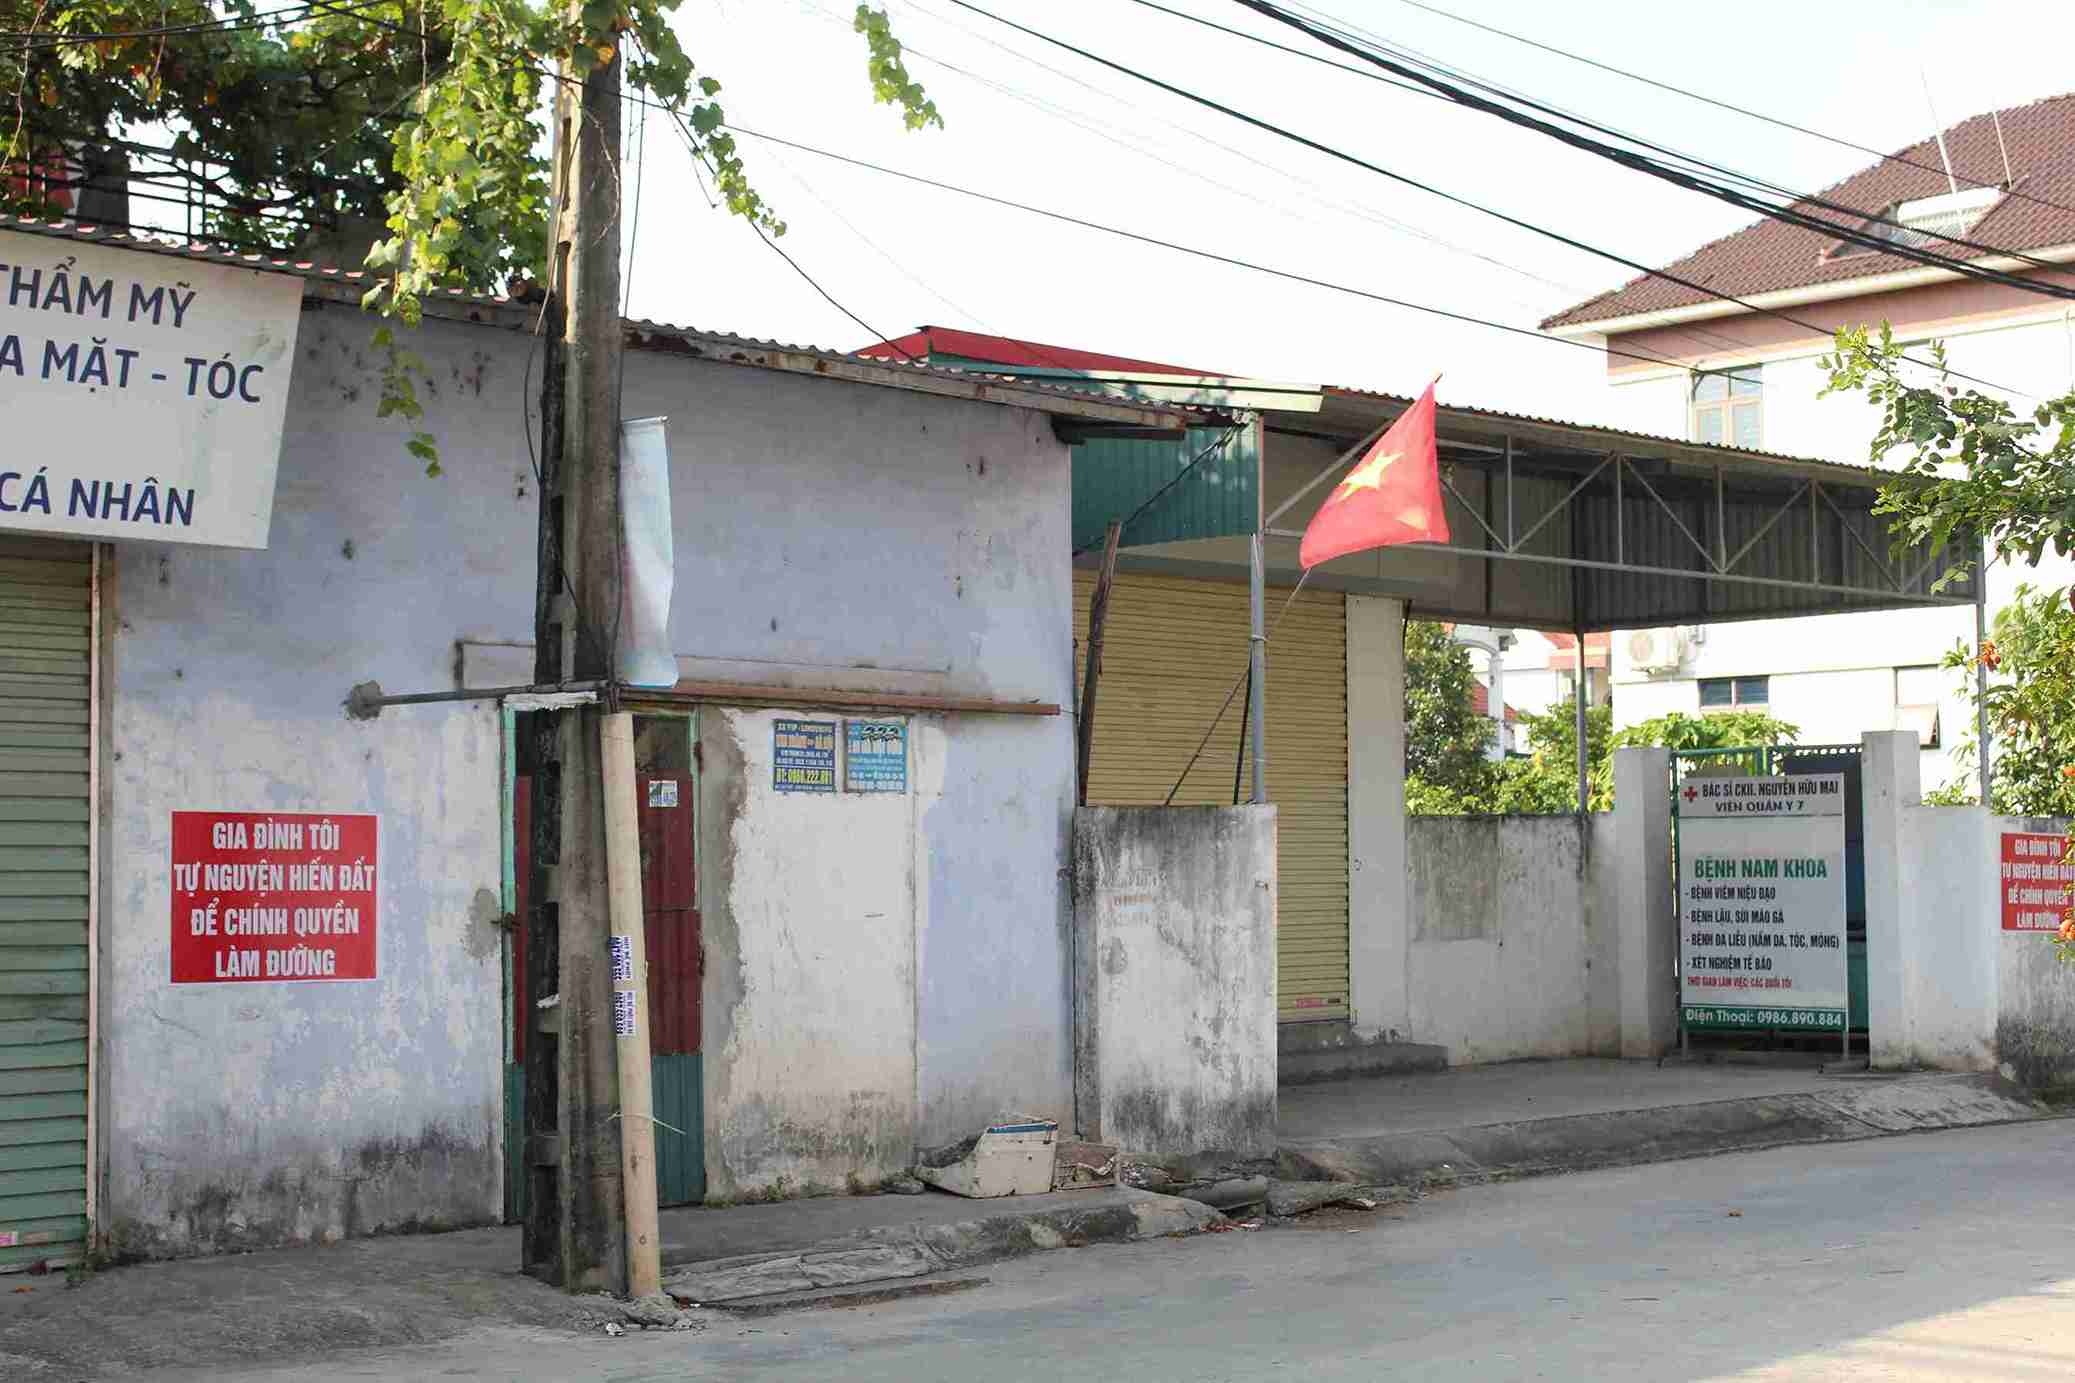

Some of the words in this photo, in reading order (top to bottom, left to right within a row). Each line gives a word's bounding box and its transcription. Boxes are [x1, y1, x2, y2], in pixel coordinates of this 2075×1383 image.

[128, 281, 196, 328] MỸ
[41, 336, 139, 392] MẶT
[184, 353, 264, 403] TÓC
[0, 466, 51, 514] CÁ
[68, 476, 195, 526] NHÂN
[1820, 780, 1838, 794] MAI
[1784, 801, 1793, 811] Y
[212, 822, 248, 849] GIA
[254, 817, 303, 850] ĐÌNH
[308, 818, 340, 850] TÔI
[173, 862, 201, 897] TỰ
[205, 859, 284, 897] NGUYỆN
[288, 856, 333, 891] HIẾN
[339, 856, 374, 891] ĐẤT
[1695, 855, 1736, 882] BỆNH
[1741, 859, 1778, 878] NAM
[1784, 859, 1827, 878] KHOA
[191, 897, 220, 936] ĐỂ
[224, 902, 288, 935] CHÍNH
[294, 899, 359, 937] QUYỀN
[1716, 933, 1727, 946] DA
[215, 945, 260, 977] LÀM
[266, 944, 336, 977] ĐƯỜNG
[1686, 1009, 1713, 1025] Điện
[1717, 1010, 1753, 1026] Thoại:
[1758, 1011, 1841, 1026] 0986.890.884
